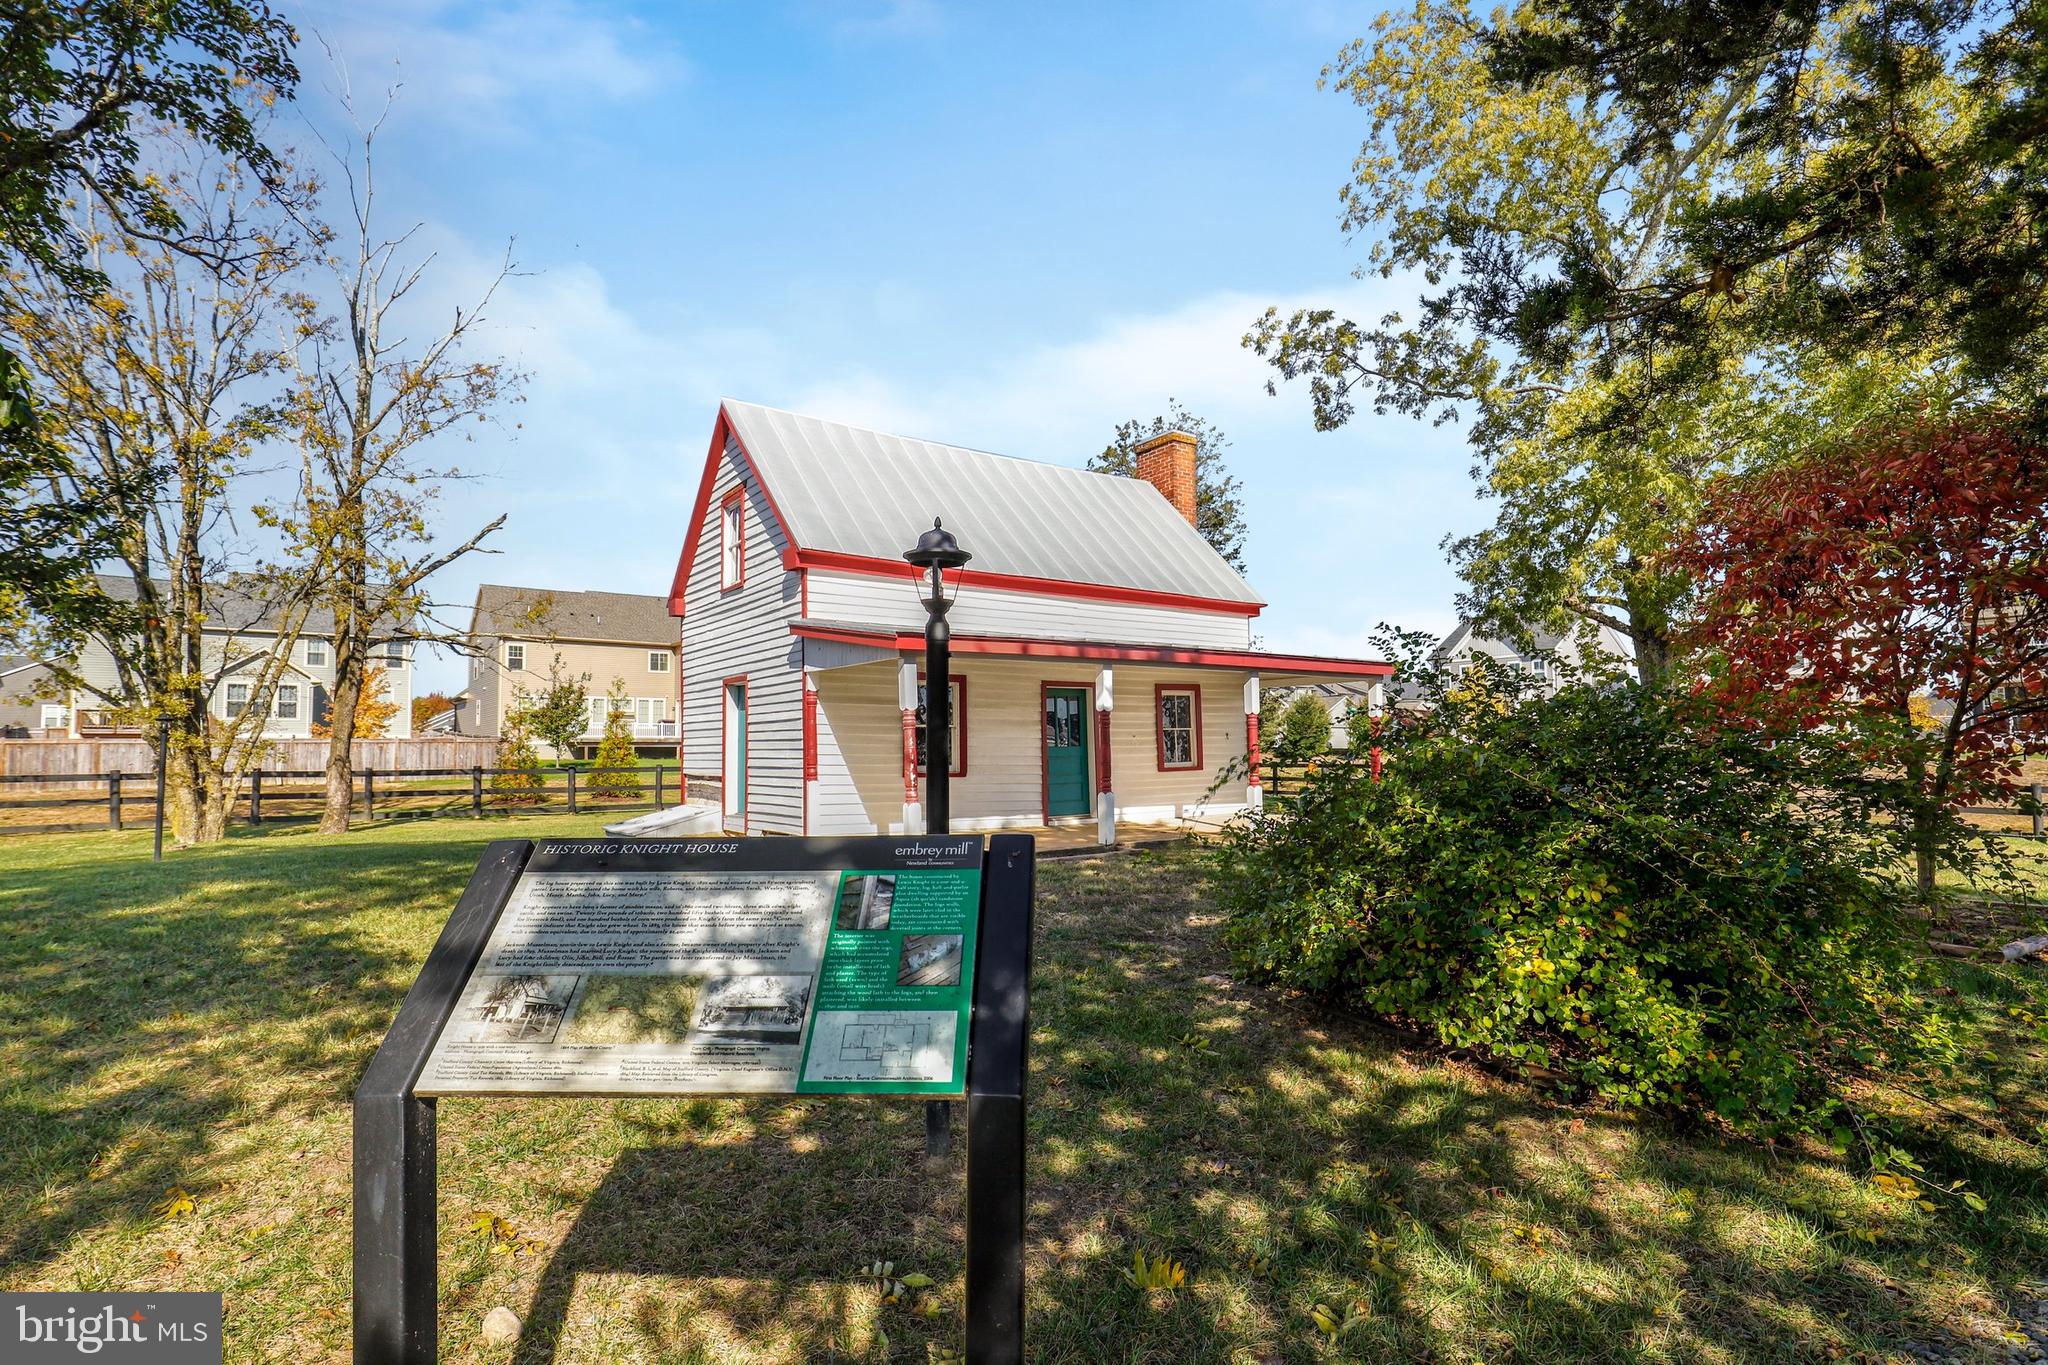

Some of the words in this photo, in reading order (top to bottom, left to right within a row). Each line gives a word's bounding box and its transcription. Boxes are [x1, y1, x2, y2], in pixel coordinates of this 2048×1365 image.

[543, 844, 618, 855] HISTORIC
[619, 844, 683, 854] KNIGHT
[684, 843, 738, 854] HOUSE
[895, 842, 942, 858] embrey
